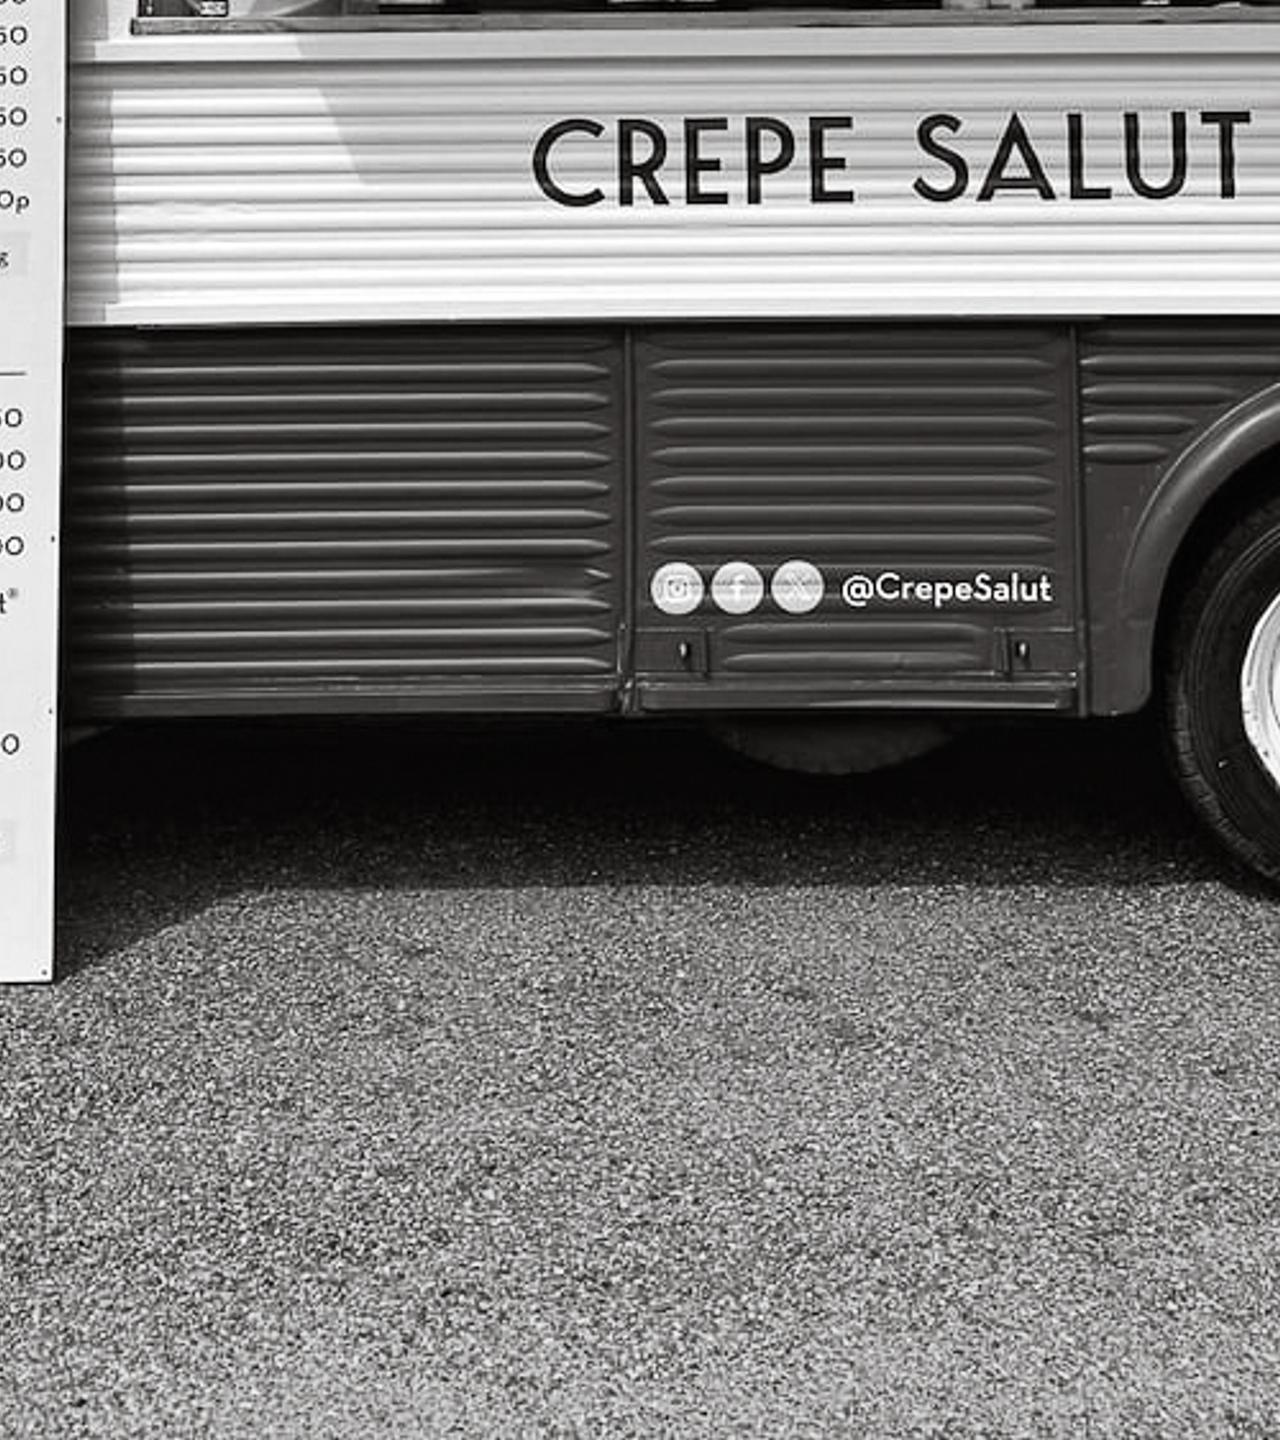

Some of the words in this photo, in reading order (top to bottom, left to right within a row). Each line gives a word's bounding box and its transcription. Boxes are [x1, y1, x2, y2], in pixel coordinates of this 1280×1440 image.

[533, 117, 853, 206] CREPE
[914, 111, 1250, 201] SALUT
[843, 573, 1051, 607] @CrepeSalut
